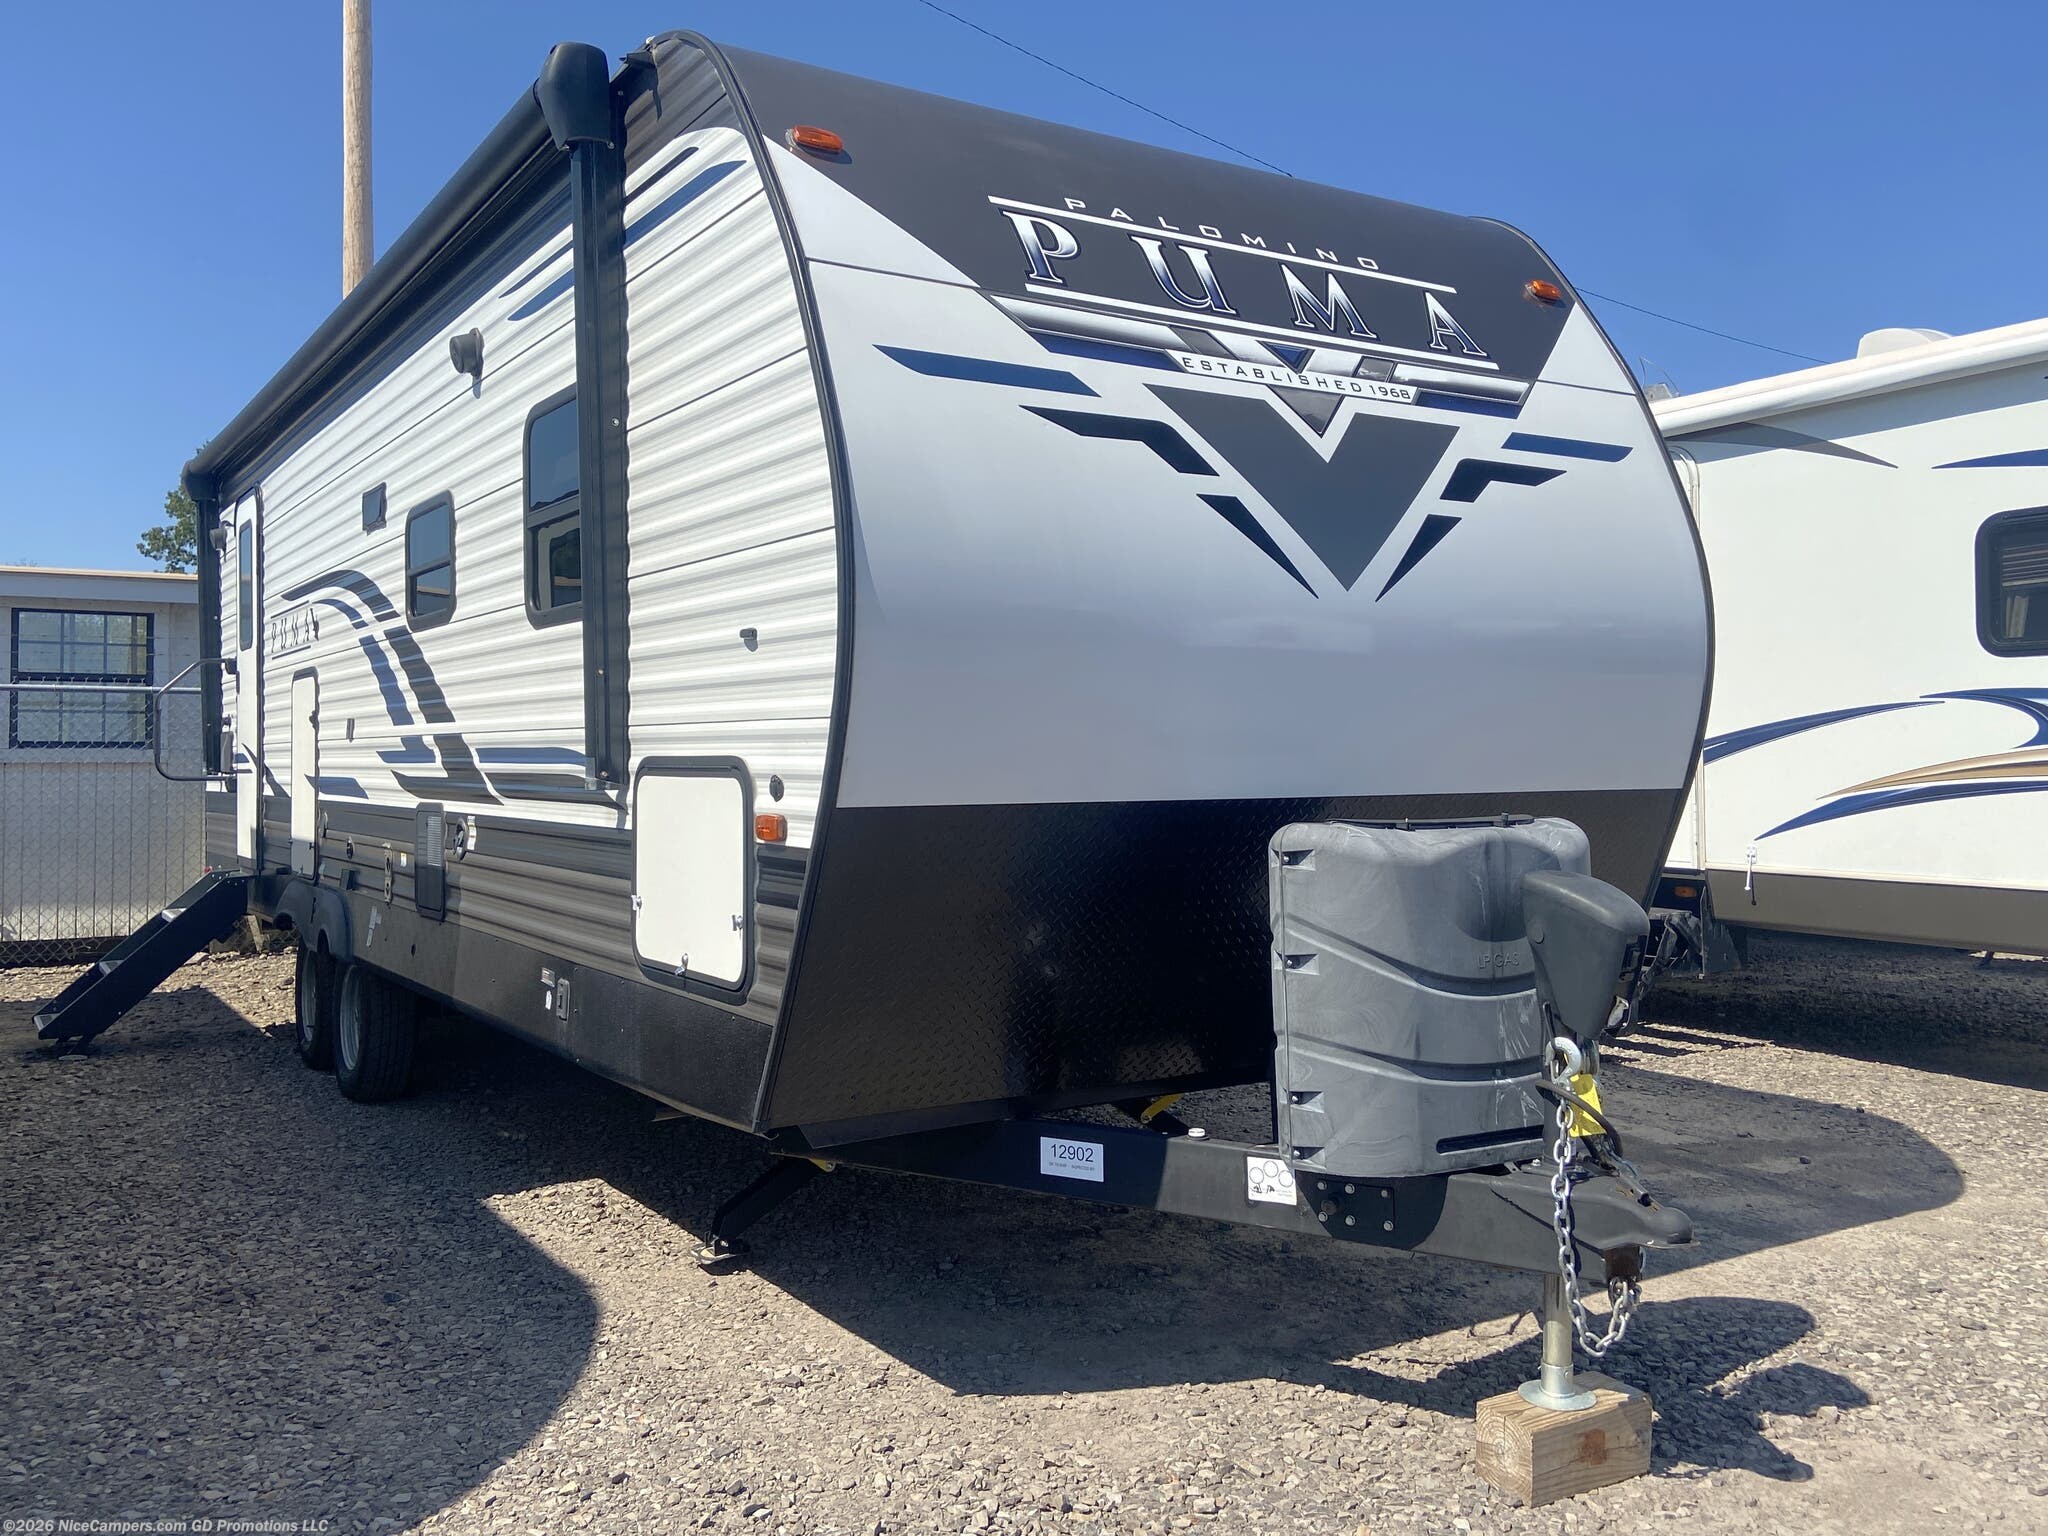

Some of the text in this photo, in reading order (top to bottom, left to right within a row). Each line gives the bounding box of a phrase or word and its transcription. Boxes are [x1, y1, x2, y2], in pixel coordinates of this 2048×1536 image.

[1063, 197, 1379, 271] PALOMINO
[1000, 207, 1490, 358] PUMA
[1182, 357, 1412, 400] ESTABLISHED 1968
[1050, 1143, 1095, 1163] 12902
